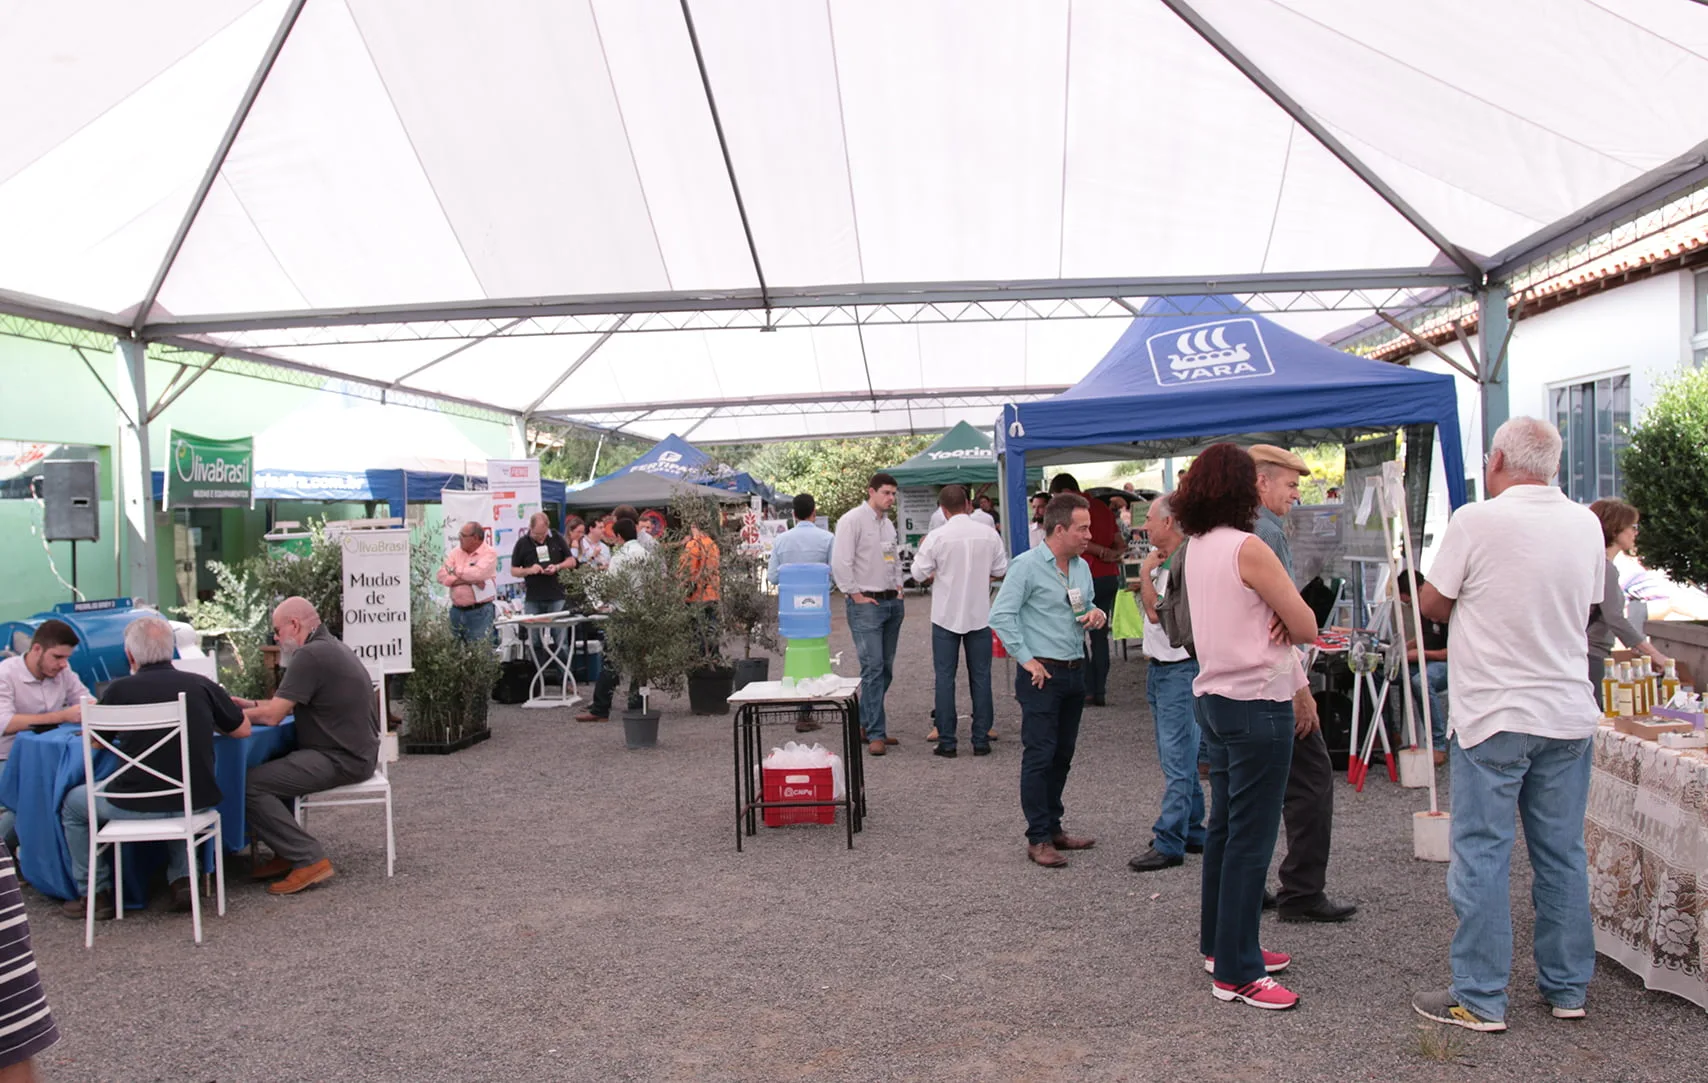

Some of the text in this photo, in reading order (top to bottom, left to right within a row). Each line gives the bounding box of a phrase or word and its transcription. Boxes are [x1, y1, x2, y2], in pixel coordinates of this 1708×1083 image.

[1171, 361, 1257, 381] YARA
[175, 438, 250, 483] OlivaBrasil
[928, 446, 993, 460] Yoorin
[343, 535, 408, 554] OlivaBrasil
[350, 572, 401, 588] Mudas
[365, 590, 386, 606] de
[344, 607, 407, 624] Oliveira
[353, 638, 403, 660] aqui!
